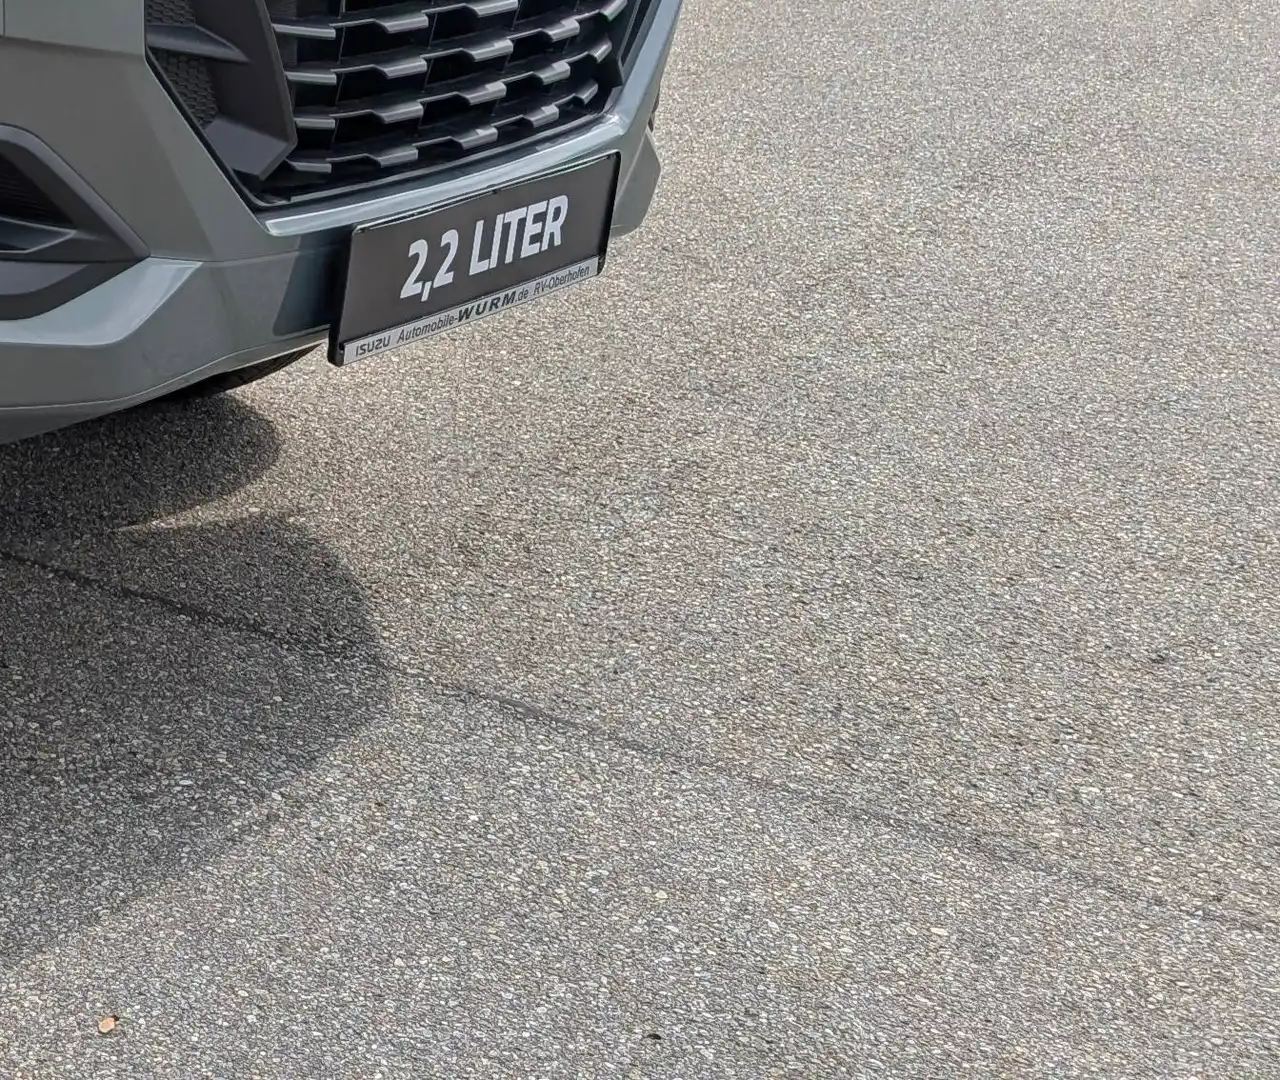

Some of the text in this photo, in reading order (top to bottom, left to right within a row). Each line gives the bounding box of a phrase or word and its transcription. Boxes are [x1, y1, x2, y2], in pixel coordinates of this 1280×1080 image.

[399, 194, 569, 302] 2,2 LITER
[355, 265, 590, 357] ISUZU Automobile-WURM.de RV-Oberhofen
